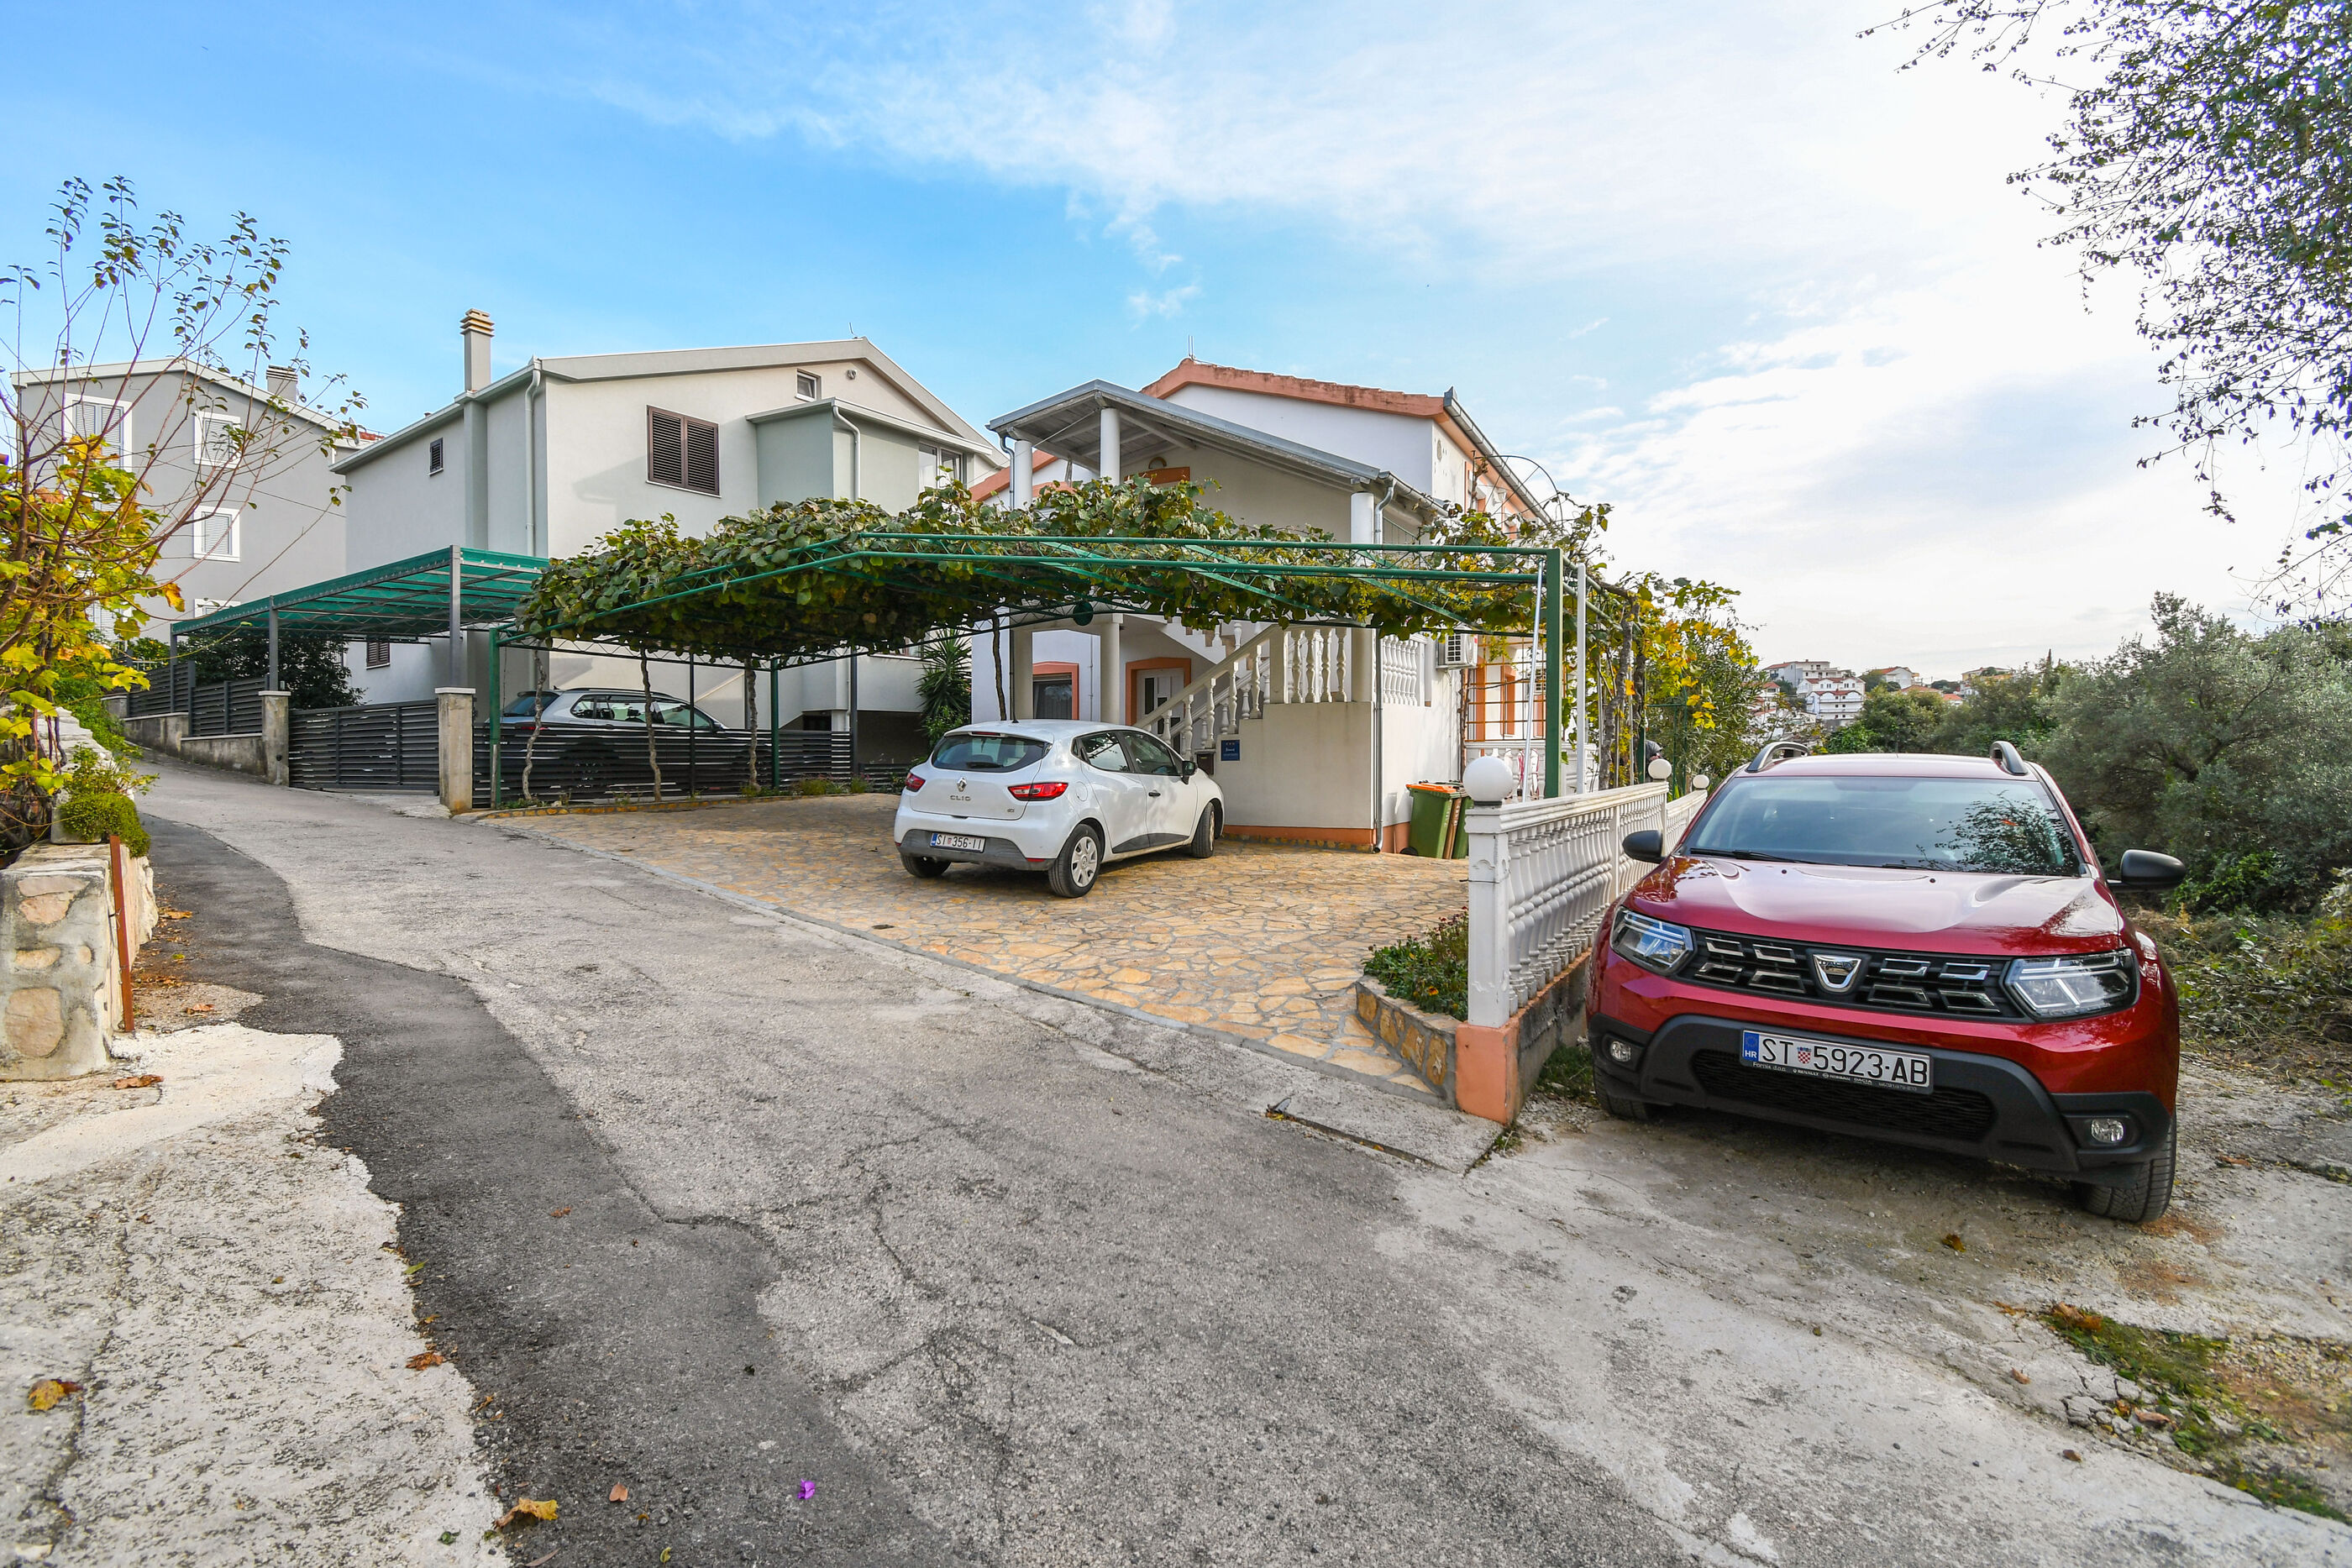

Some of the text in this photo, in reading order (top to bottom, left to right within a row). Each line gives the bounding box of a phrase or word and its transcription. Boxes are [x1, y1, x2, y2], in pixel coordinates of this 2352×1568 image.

[937, 834, 946, 845] SI
[1745, 1050, 1757, 1058] HR
[1762, 1038, 1793, 1064] ST
